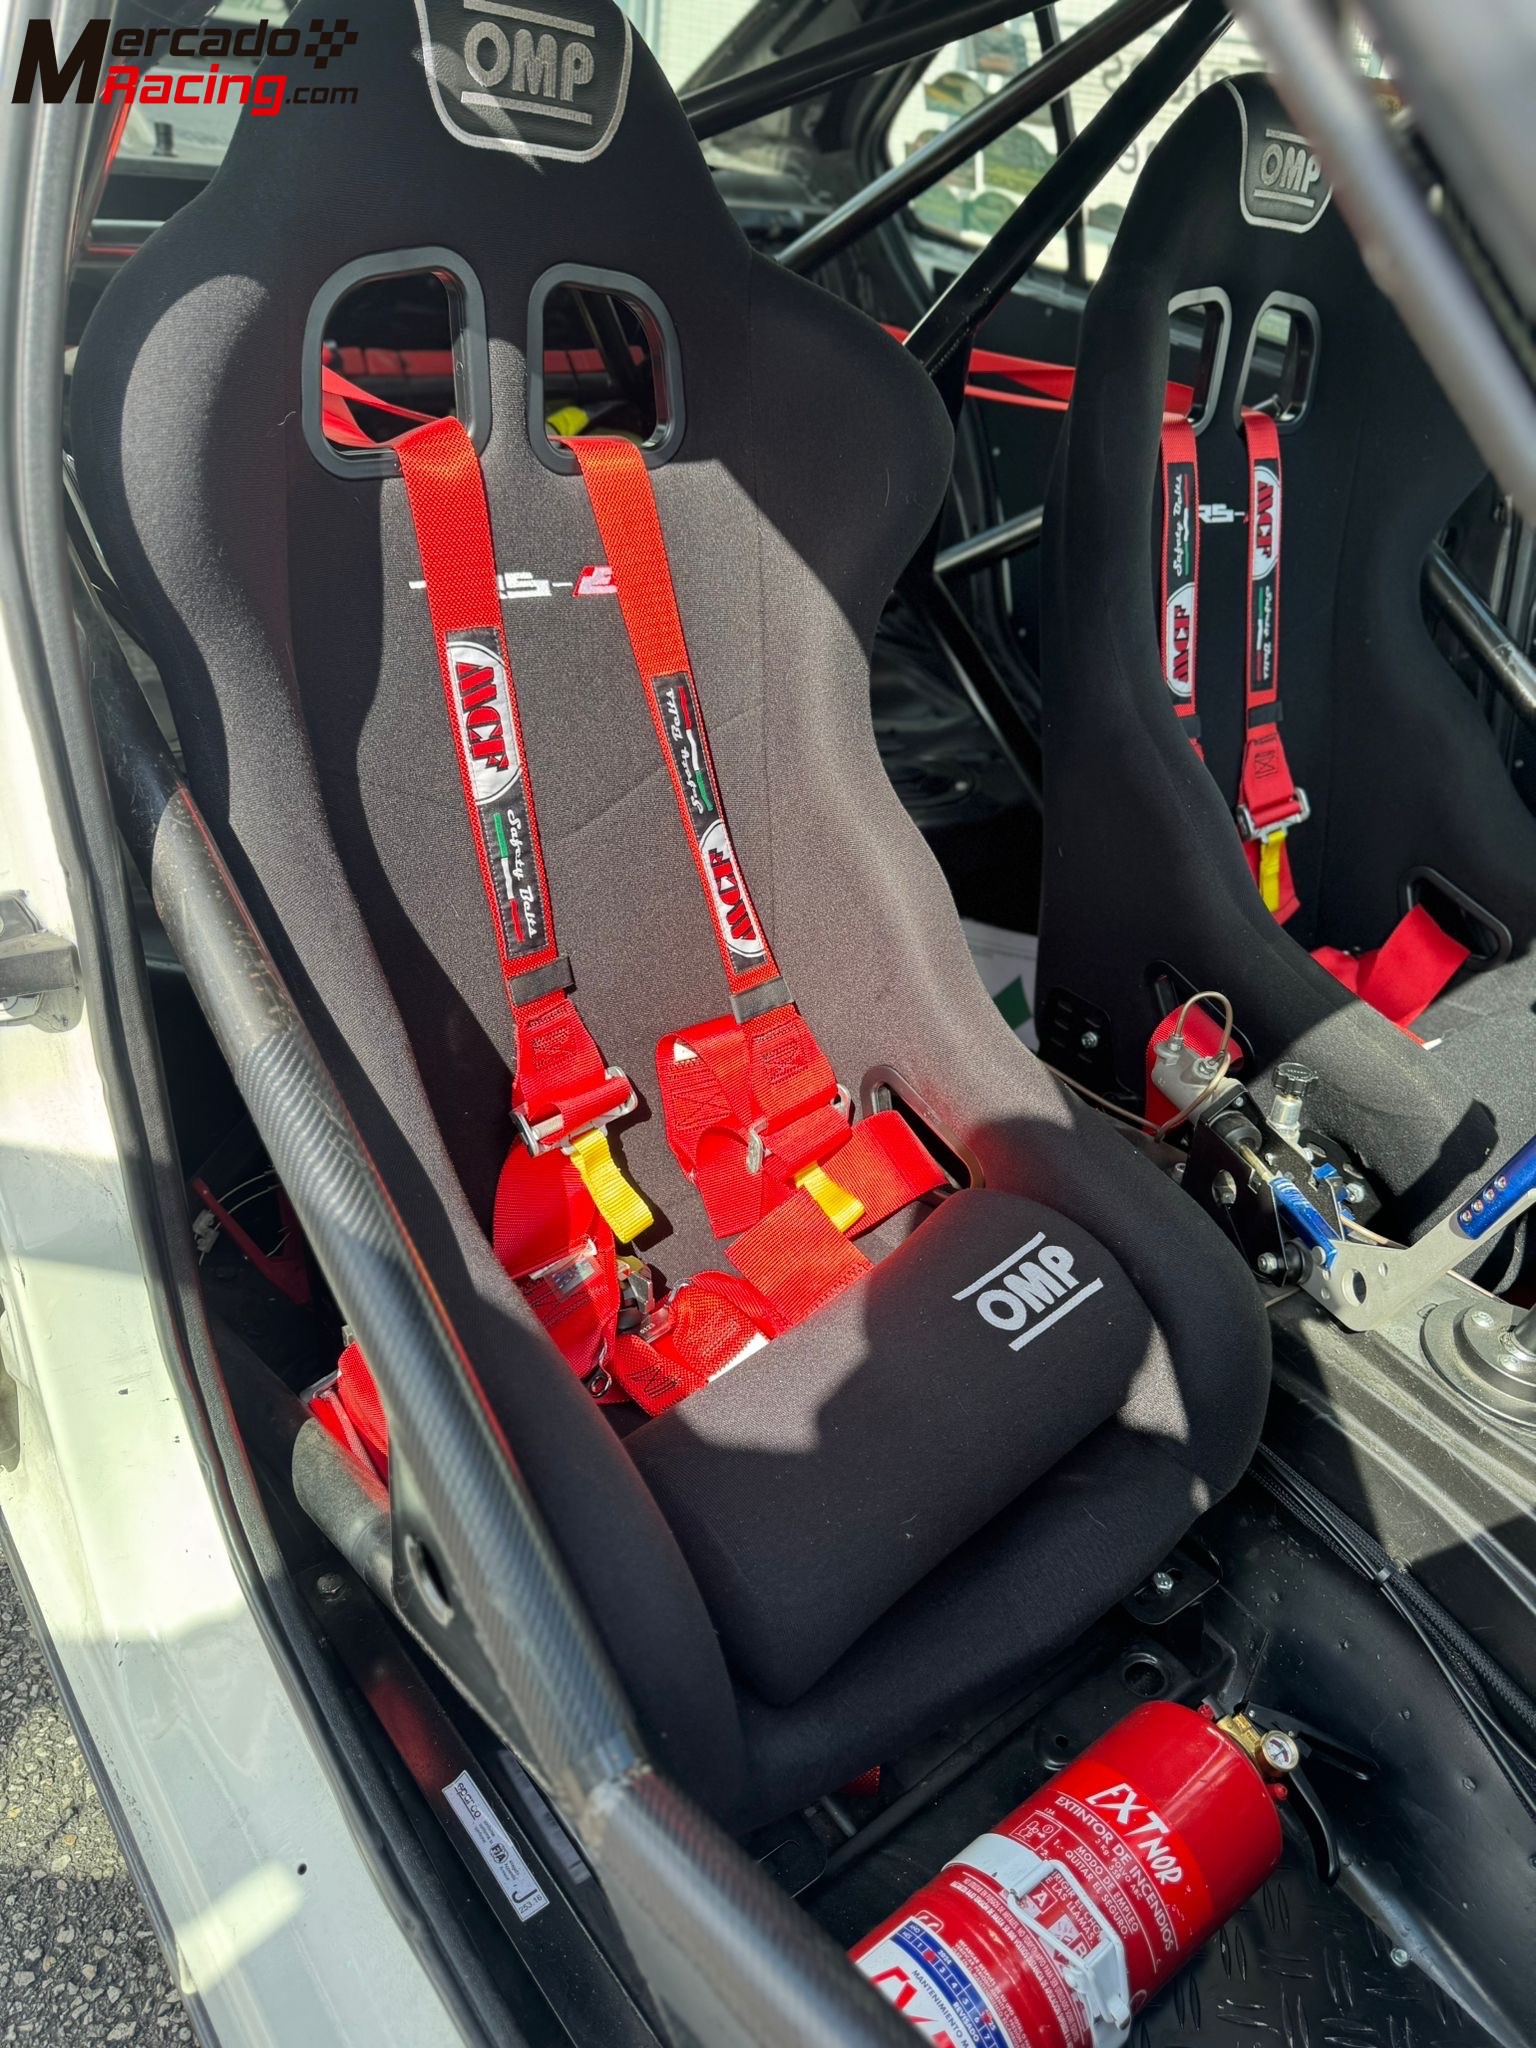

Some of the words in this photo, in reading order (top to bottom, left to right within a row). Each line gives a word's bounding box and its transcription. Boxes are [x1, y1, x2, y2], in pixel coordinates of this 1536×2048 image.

[463, 20, 596, 102] OMP
[1260, 144, 1321, 191] OMP
[1173, 475, 1182, 515] Belts
[1257, 481, 1274, 558] MCF
[1173, 520, 1185, 576] Safety
[1173, 605, 1190, 683] MCF
[456, 662, 509, 772] MCF
[666, 688, 683, 741] Belts
[681, 747, 703, 814] Safety
[508, 810, 524, 880] Safety
[519, 886, 536, 938] Belts
[708, 848, 756, 940] MCF
[976, 1244, 1083, 1331] OMP
[1032, 1890, 1048, 1907] A
[1052, 1871, 1076, 1898] IRIGIR
[1075, 1898, 1086, 1911] EL
[1056, 1796, 1113, 1844] EXTINTOR
[1112, 1844, 1132, 1866] DE
[1129, 1865, 1173, 1950] INCENDIOS
[1065, 1850, 1094, 1882] QUITAR
[1093, 1882, 1102, 1893] EL
[1101, 1893, 1128, 1938] SEGURO.
[1076, 1846, 1103, 1876] MODO
[1101, 1876, 1115, 1890] DE
[1112, 1892, 1138, 1931] EMPLEO
[1112, 1858, 1130, 1882] POLVO
[1052, 1883, 1068, 1900] LAS
[1066, 1901, 1094, 1944] LLAMAS.
[938, 1950, 952, 1964] 2024
[912, 1970, 962, 2038] MANTENIMIENTO
[950, 2002, 980, 2041] REVISADO
